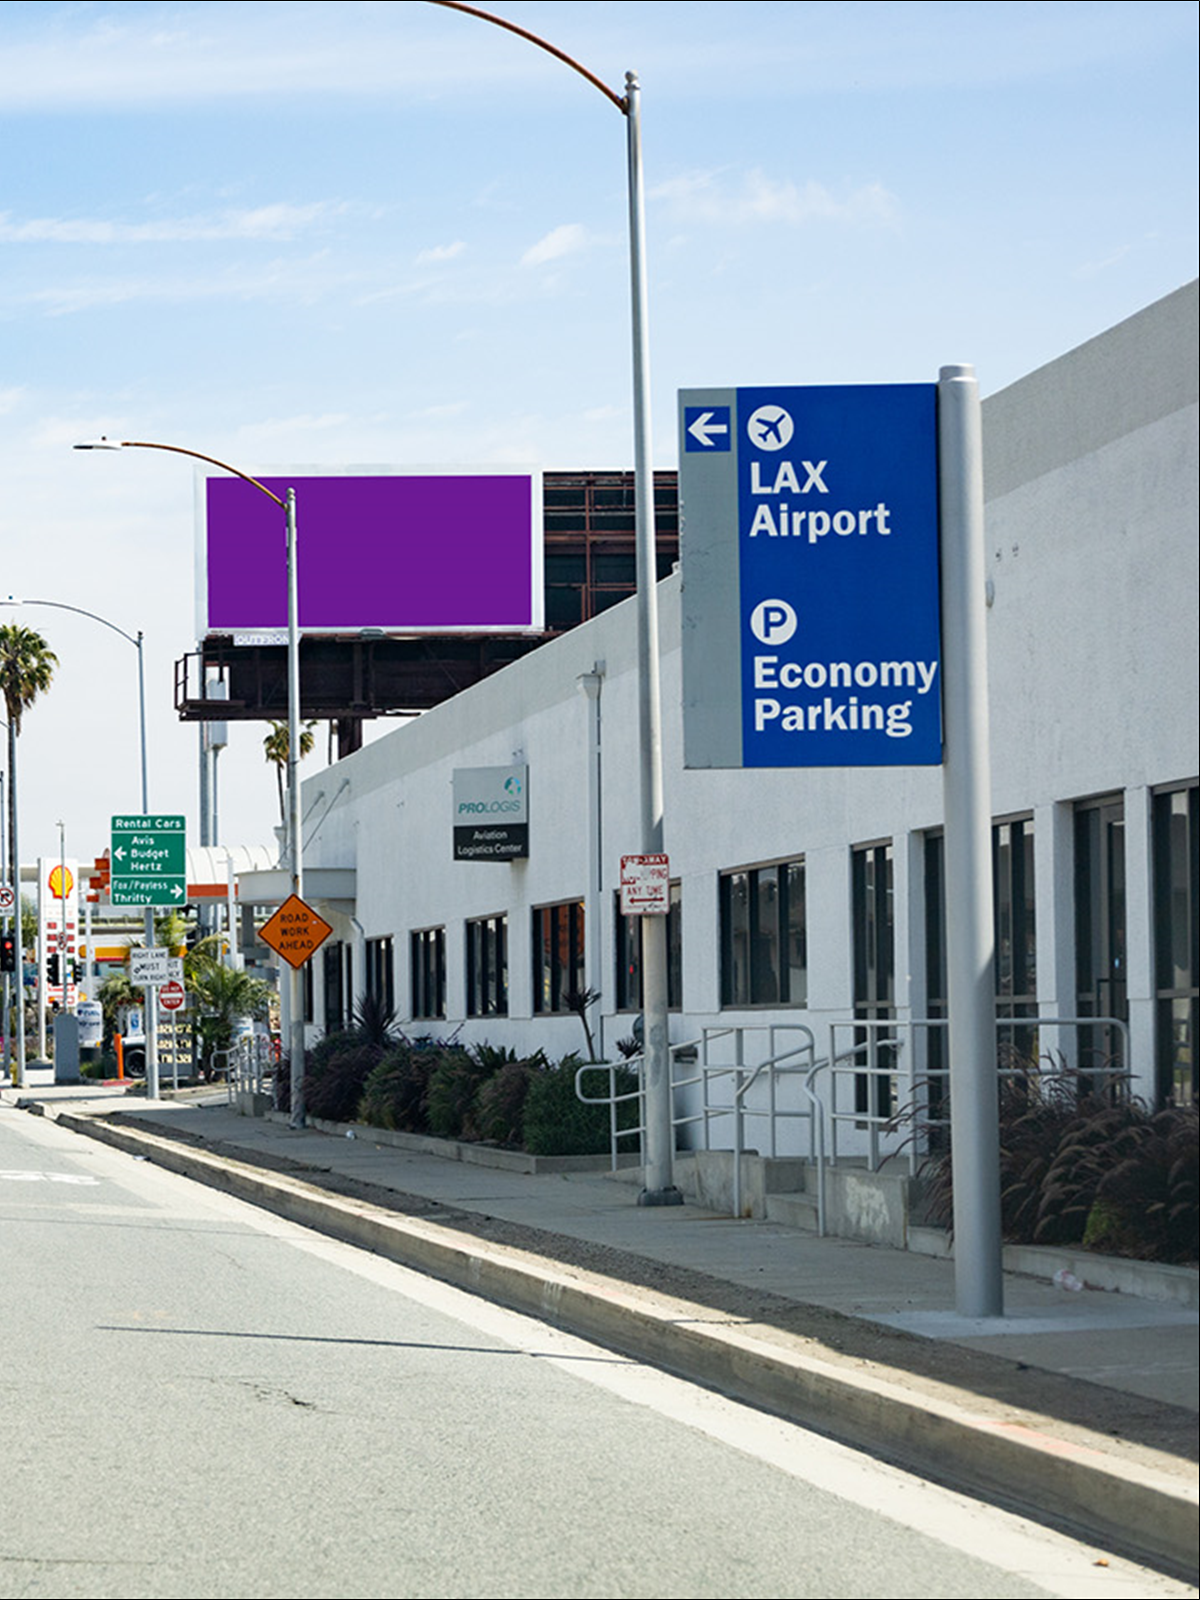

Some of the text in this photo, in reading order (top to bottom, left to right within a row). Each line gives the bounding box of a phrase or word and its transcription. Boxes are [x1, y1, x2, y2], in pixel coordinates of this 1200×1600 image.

[749, 460, 829, 495] LAX
[749, 502, 891, 543] Airport
[762, 607, 788, 638] P
[235, 633, 289, 645] OUTFRON
[753, 655, 938, 695] Economy
[754, 697, 913, 737] Parking
[458, 800, 521, 814] PROLOGIS
[115, 819, 181, 829] Rental Cars
[131, 835, 155, 845] Avis
[473, 830, 508, 840] Aviation
[130, 849, 169, 860] Budget
[457, 843, 522, 857] Logistics Center
[130, 862, 162, 871] Hertz
[627, 886, 642, 895] ANY
[114, 893, 152, 904] Thrifty
[280, 913, 309, 923] ROAD
[280, 927, 310, 937] WORK
[279, 940, 314, 950] AHEAD
[140, 962, 160, 971] MUST
